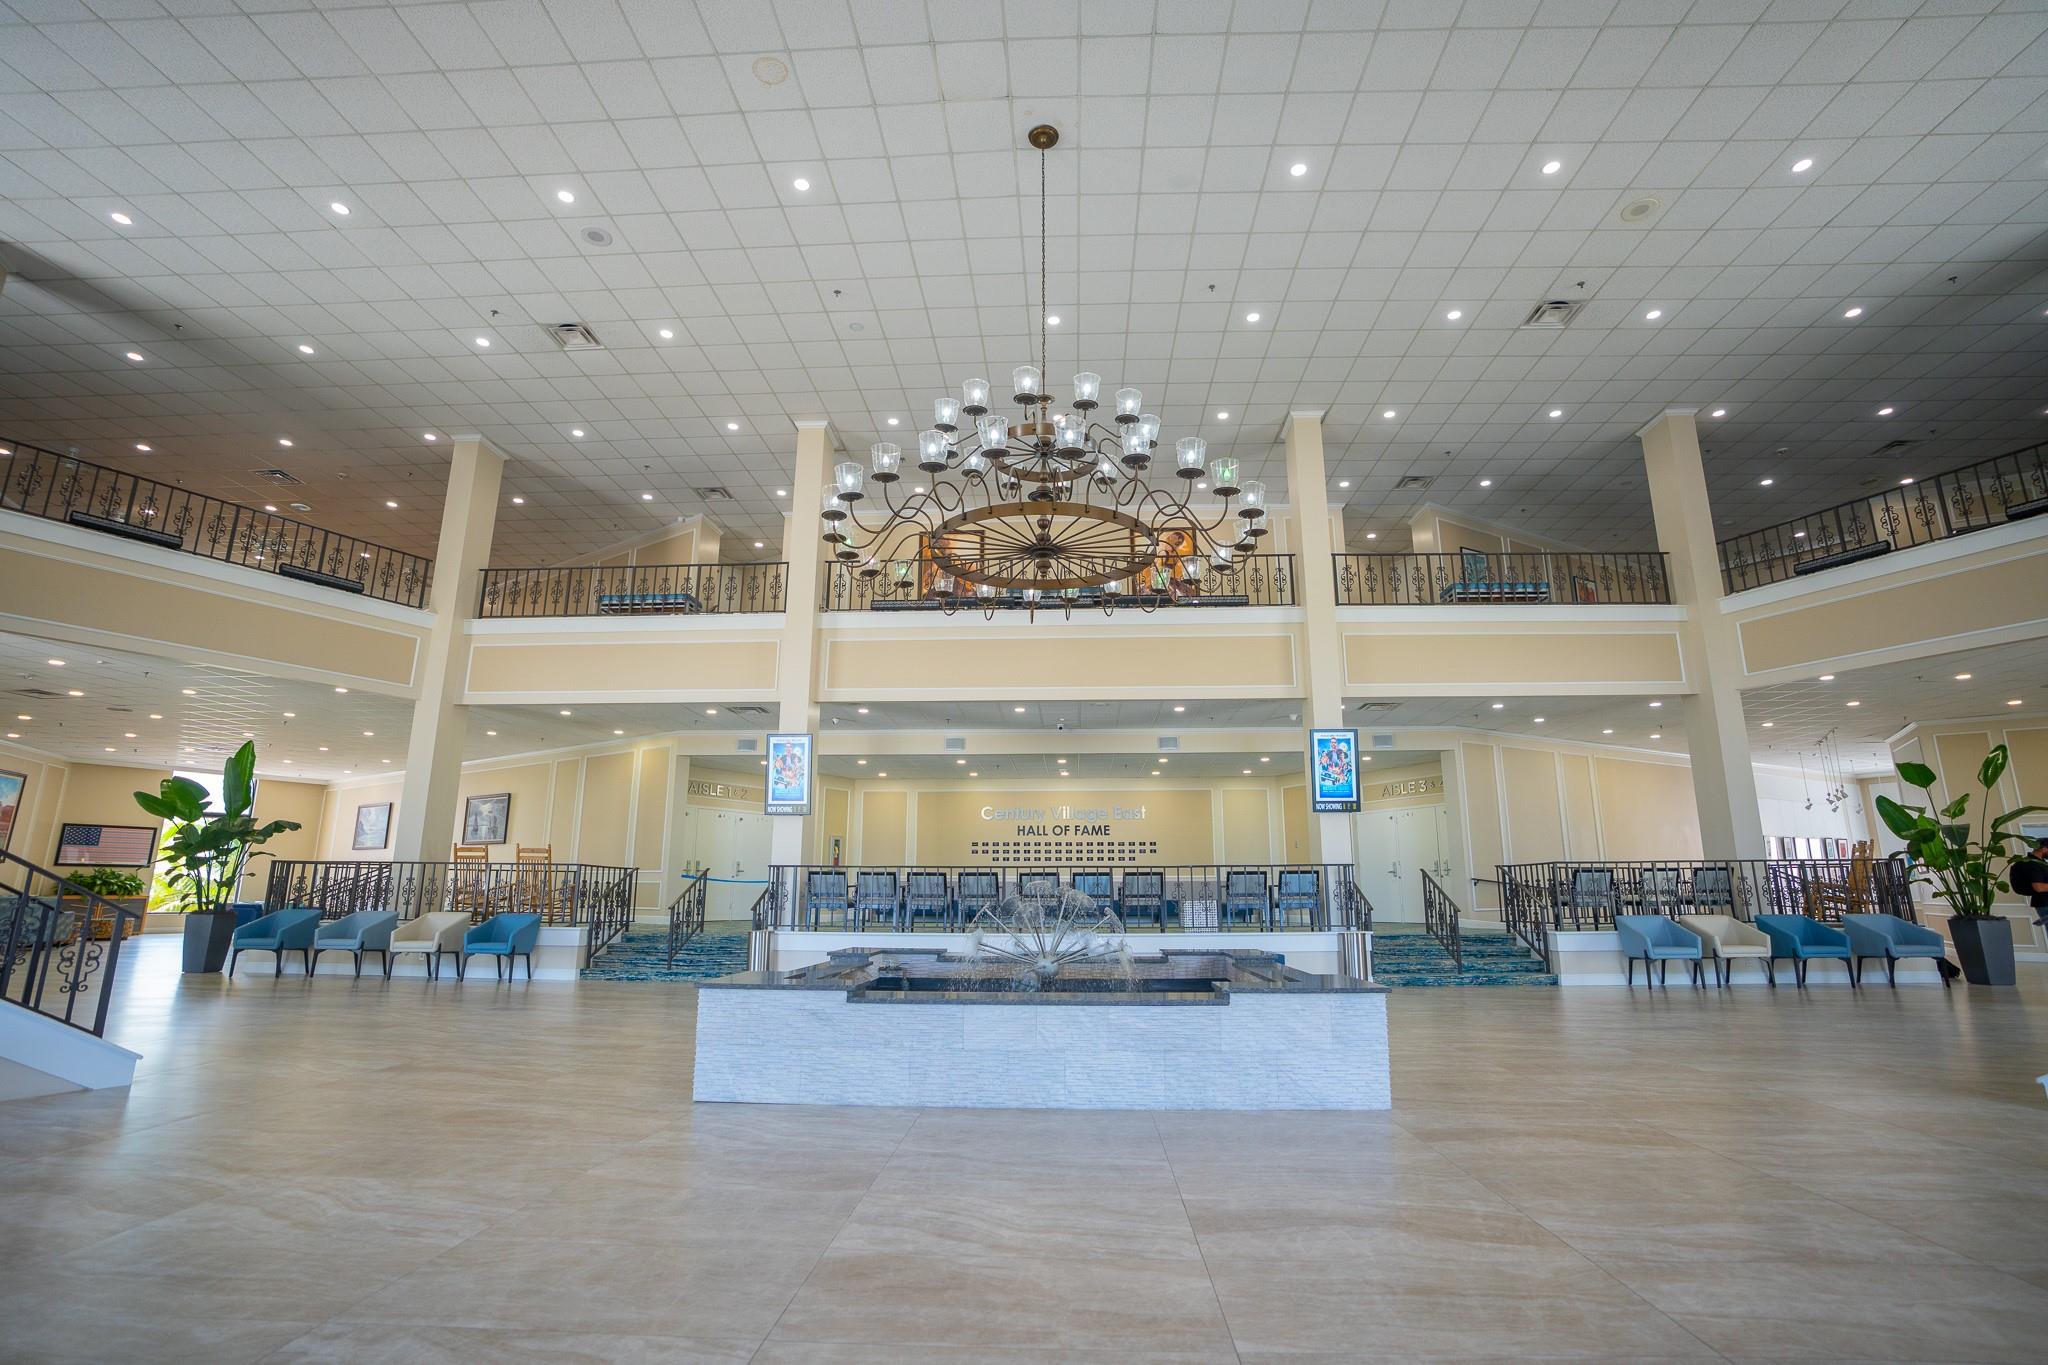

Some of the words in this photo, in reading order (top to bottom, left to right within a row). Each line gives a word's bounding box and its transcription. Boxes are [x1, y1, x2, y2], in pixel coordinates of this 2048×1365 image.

[688, 782, 724, 797] AISLE
[727, 786, 732, 798] 1
[741, 788, 748, 799] 2
[1383, 781, 1416, 797] AISLE
[1419, 780, 1427, 792] 3
[981, 806, 1044, 822] Century
[1051, 805, 1107, 822] Village
[1113, 805, 1146, 820] East
[1017, 825, 1048, 836] HALL
[1052, 825, 1070, 836] OF
[1074, 825, 1111, 836] FAME
